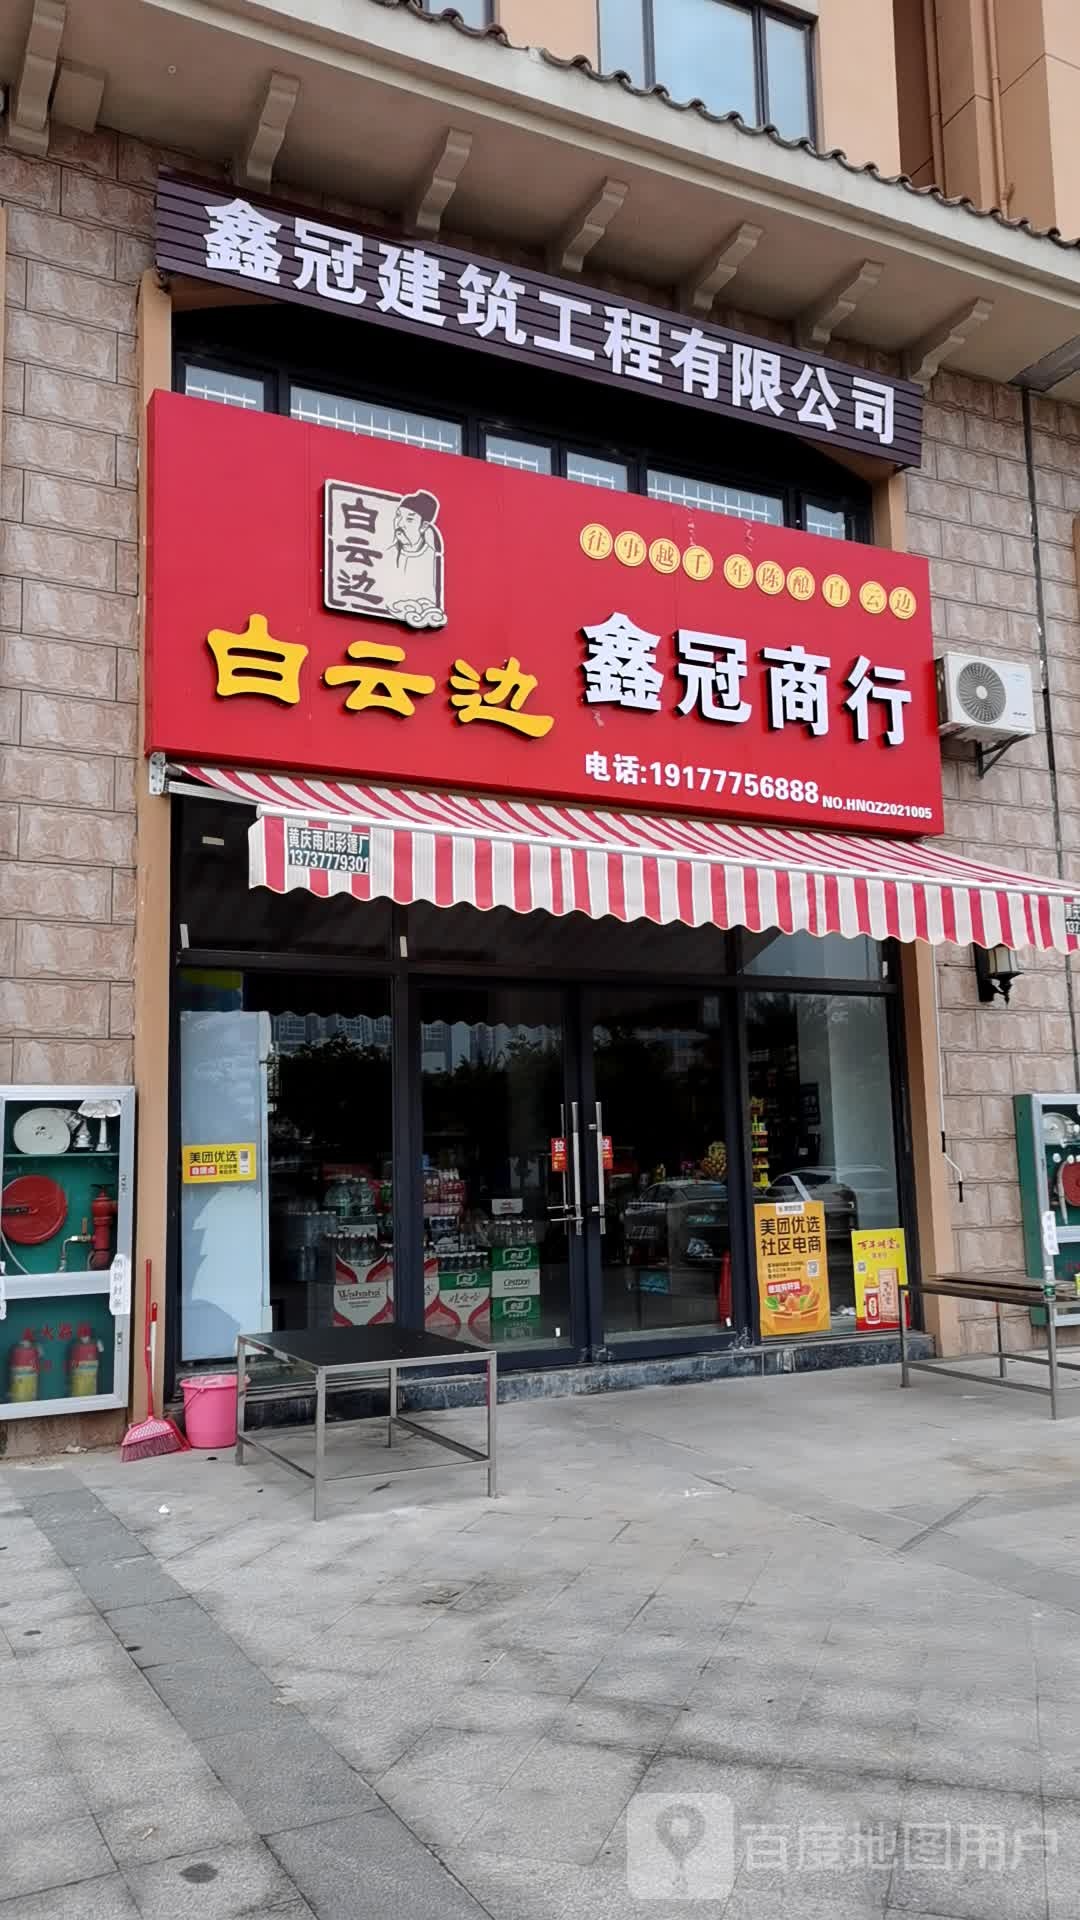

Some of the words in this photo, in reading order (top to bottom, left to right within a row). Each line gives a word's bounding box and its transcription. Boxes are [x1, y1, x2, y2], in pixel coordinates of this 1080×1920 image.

[203, 197, 896, 445] 鑫冠建筑工程有限公司
[336, 497, 383, 605] 白云边
[585, 526, 914, 618] 往事越千年陈酿白云边
[207, 614, 555, 738] 白云边
[581, 611, 912, 745] 鑫冠商行
[585, 750, 819, 804] 电话:19177756888
[822, 795, 933, 820] NO.HNQZ2021005
[289, 849, 370, 873] 13737779301
[189, 1150, 237, 1164] 美团优选
[760, 1216, 821, 1236] 美团优选
[761, 1236, 822, 1256] 社区电商
